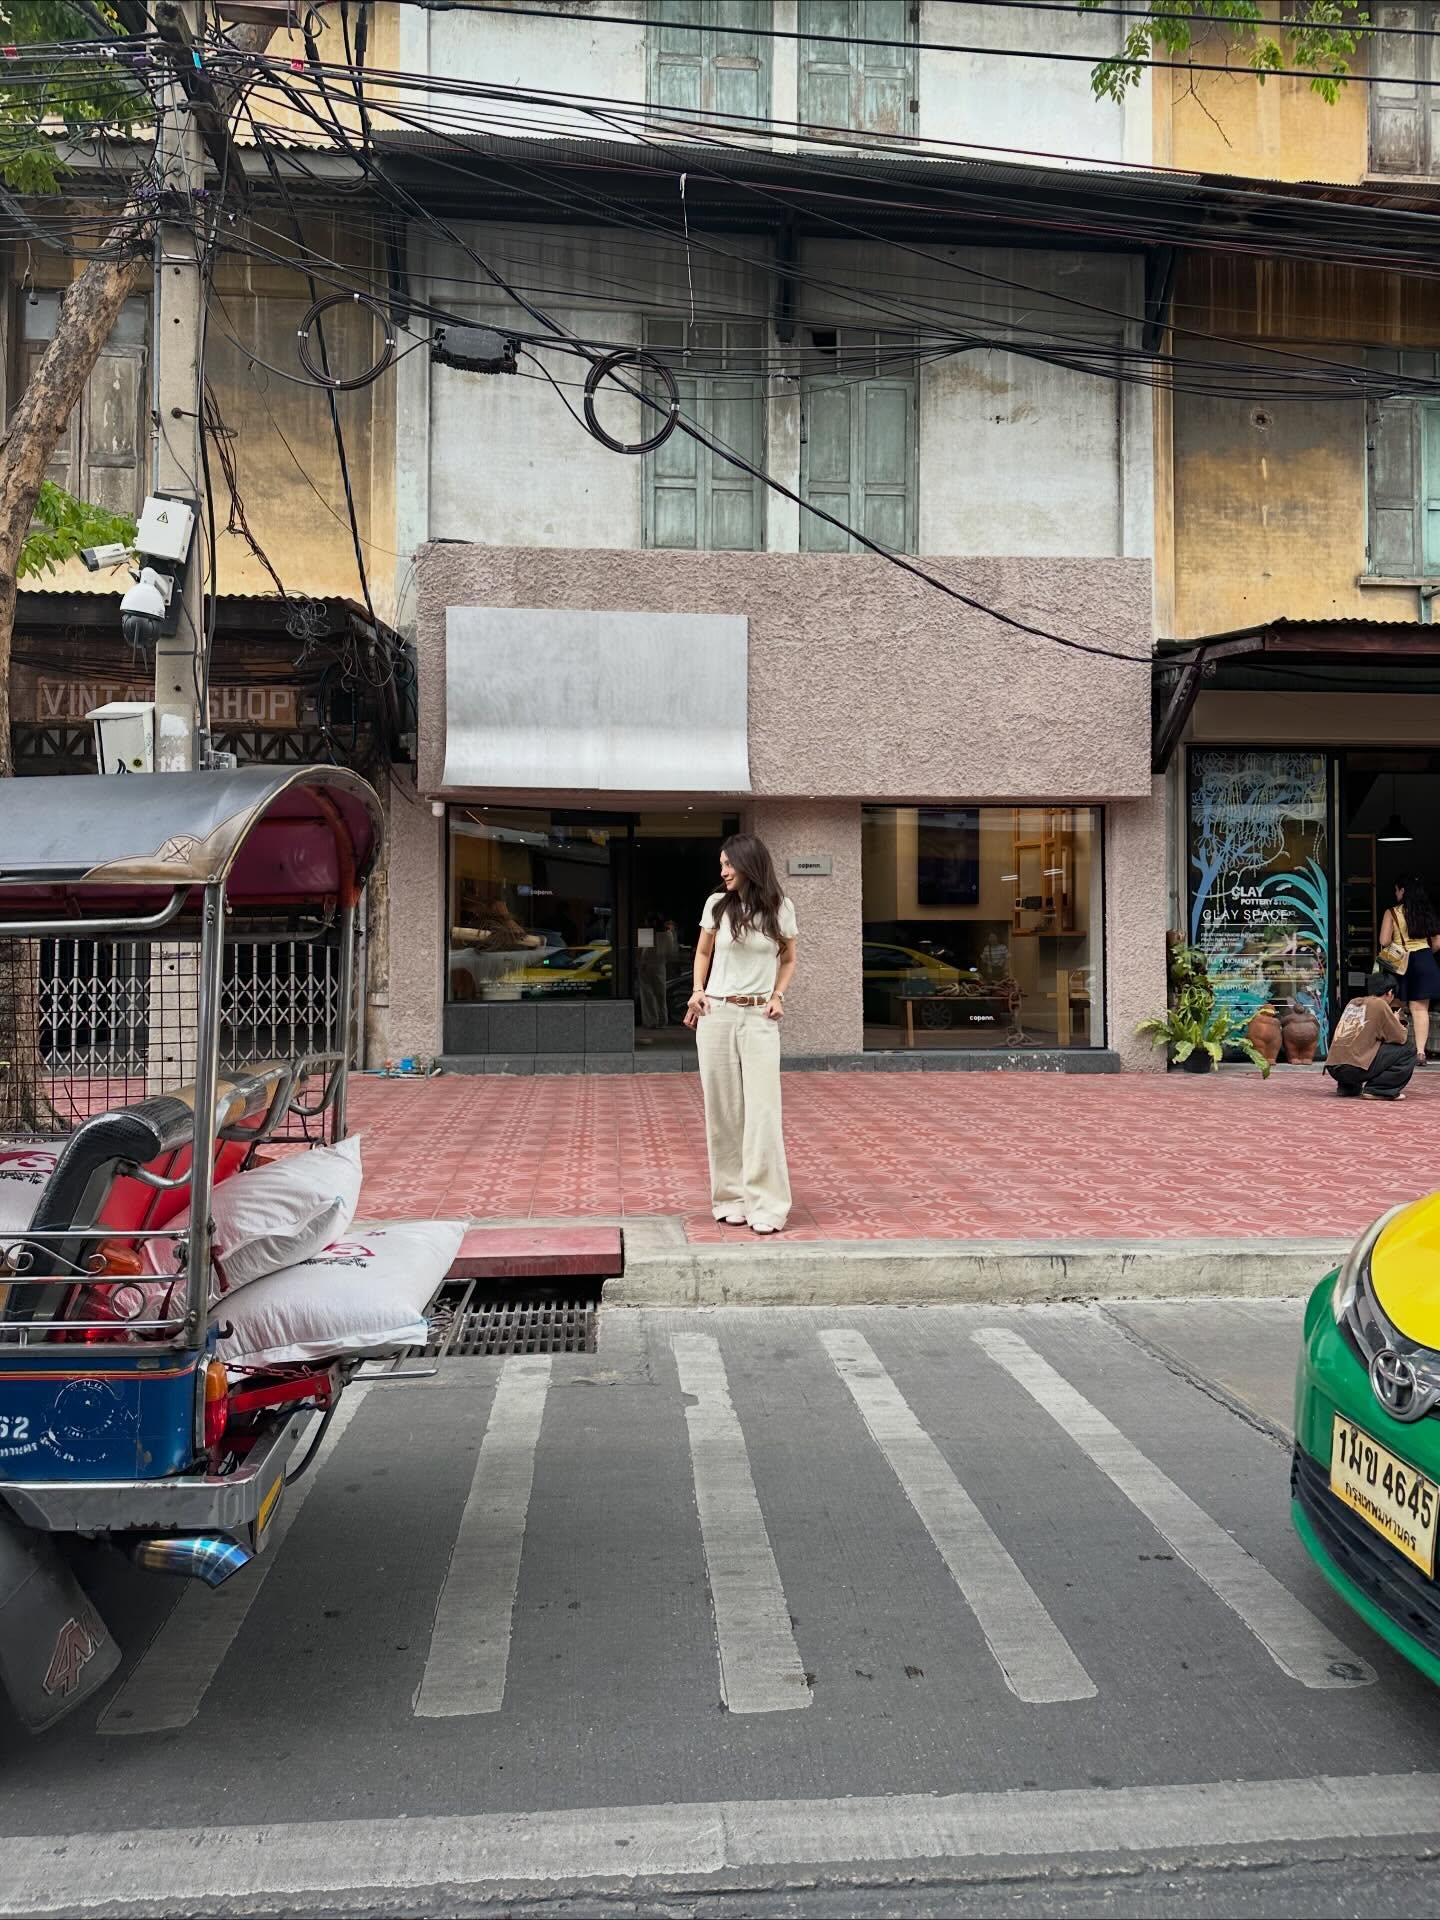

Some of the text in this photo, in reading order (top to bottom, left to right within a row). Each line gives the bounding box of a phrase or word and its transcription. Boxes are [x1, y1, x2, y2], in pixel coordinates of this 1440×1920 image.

[42, 684, 155, 715] VINTA
[1202, 909, 1239, 920] CLAY
[1243, 909, 1289, 921] SPACE
[1345, 1481, 1417, 1552] กรุงเทพมหานคร
[1382, 1462, 1433, 1529] 4645
